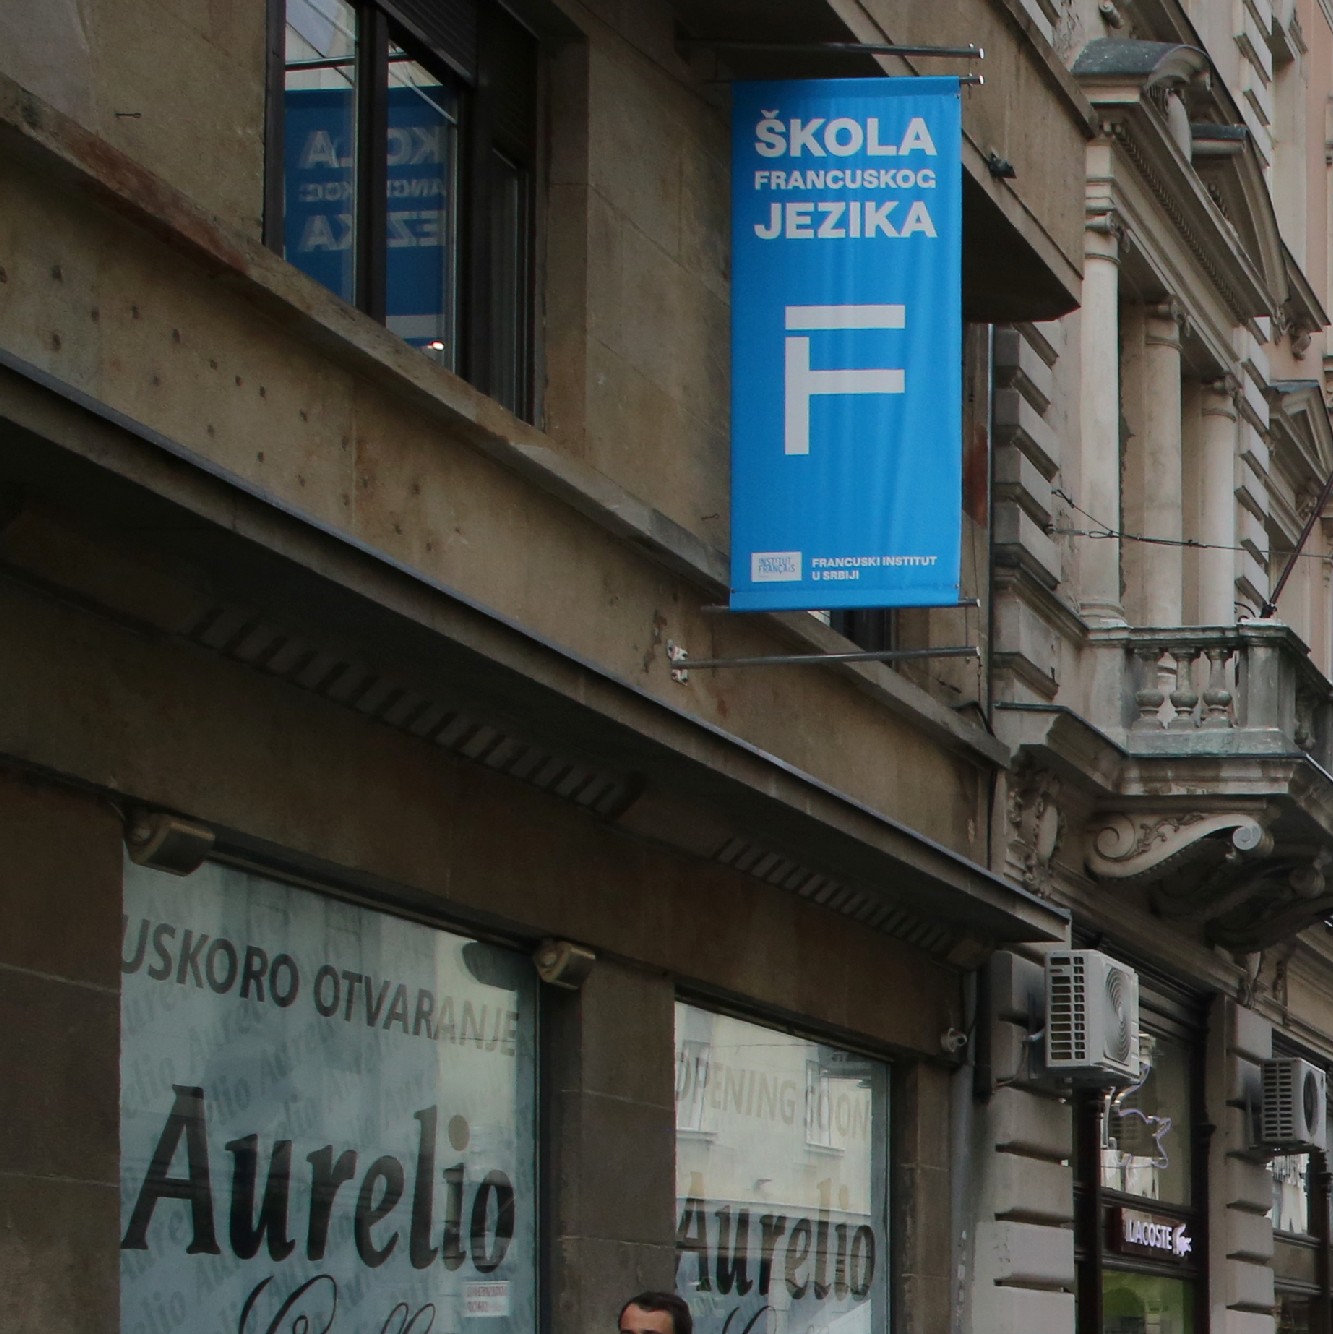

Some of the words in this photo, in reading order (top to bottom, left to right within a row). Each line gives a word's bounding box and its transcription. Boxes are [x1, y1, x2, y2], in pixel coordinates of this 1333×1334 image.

[755, 110, 937, 158] ŠKOLA
[754, 169, 937, 190] FRANCUSKOG
[754, 200, 938, 239] JEZIKA
[812, 557, 880, 567] FRANCUSKI
[882, 556, 937, 566] INSTITUT
[823, 570, 859, 580] SRBIJI
[121, 914, 299, 1008] USKORO
[313, 964, 519, 1056] OTVARANJE
[120, 1083, 515, 1273] Aurelio
[674, 1171, 876, 1300] Aurelio
[1125, 1218, 1173, 1251] LACOSTE
